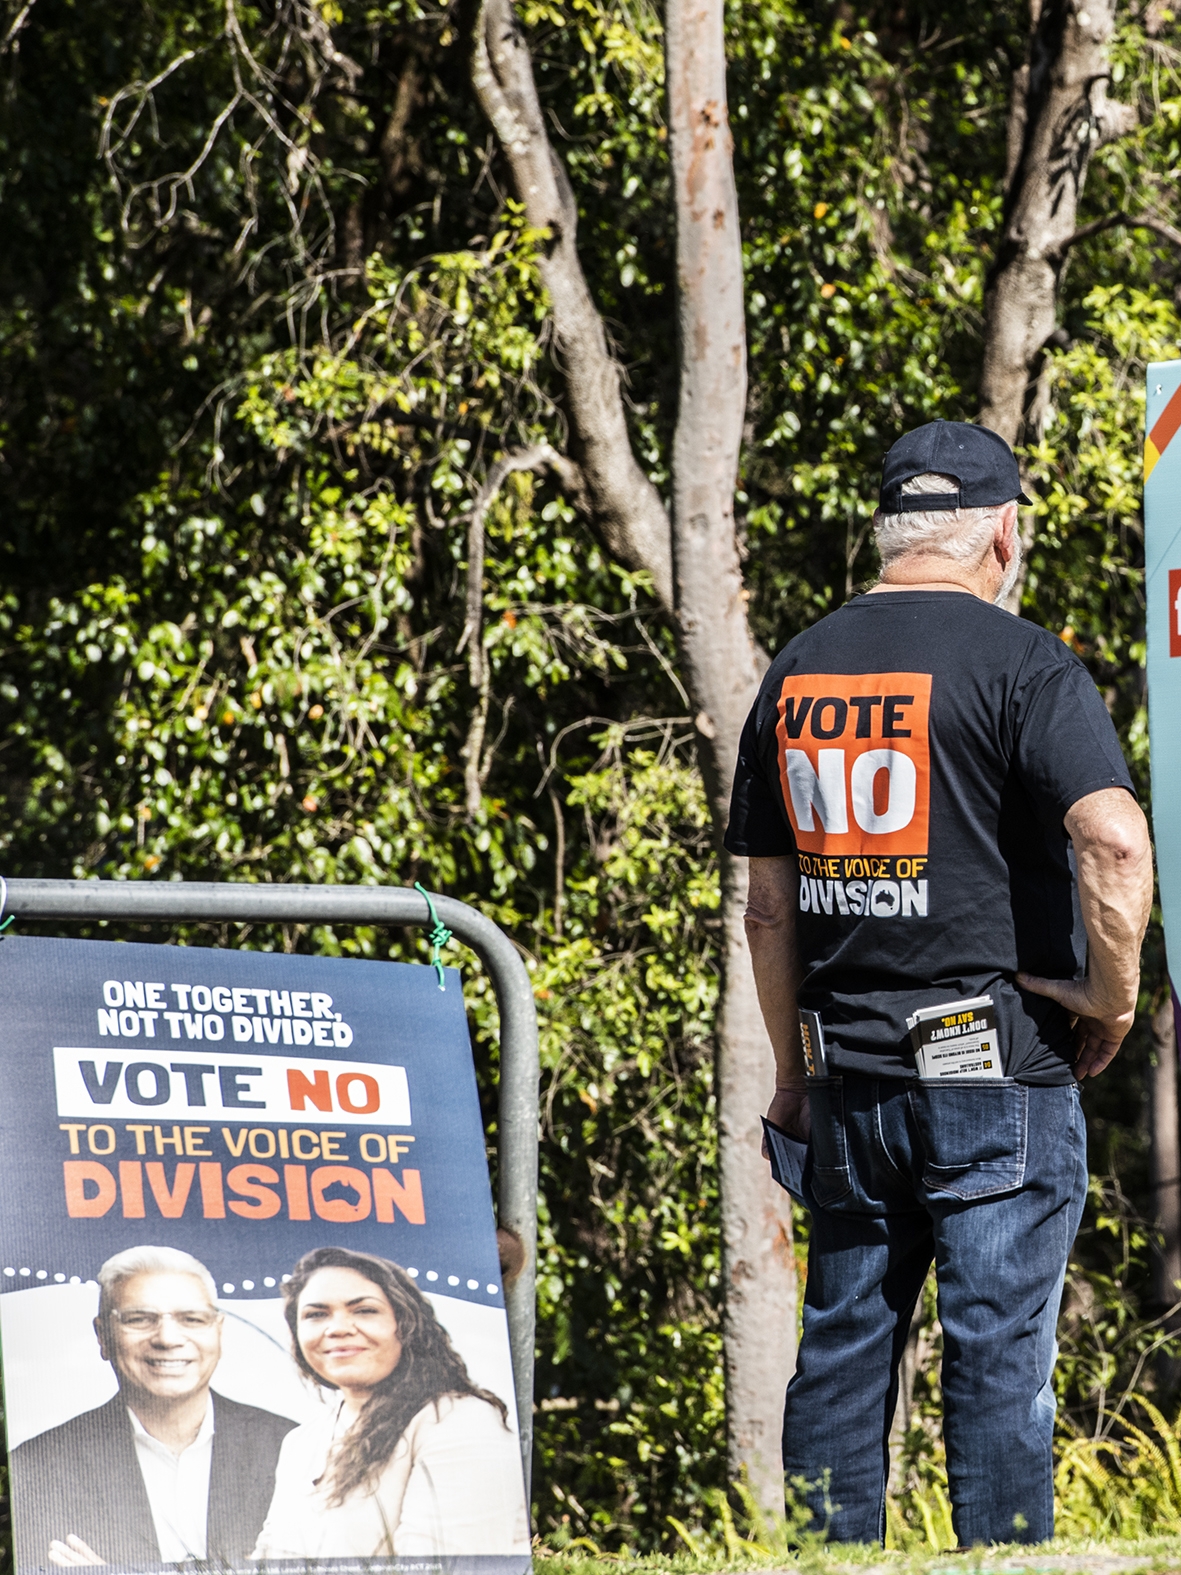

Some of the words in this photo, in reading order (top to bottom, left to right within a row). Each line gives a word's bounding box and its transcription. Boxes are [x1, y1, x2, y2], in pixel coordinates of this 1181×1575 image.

[784, 695, 913, 741] VOTE
[785, 748, 916, 835] NO
[798, 854, 812, 875] TO
[813, 857, 840, 878] THE
[844, 857, 891, 878] VOICE
[896, 858, 928, 878] OF
[799, 875, 928, 918] DIVISION
[103, 980, 168, 1010] ONE
[171, 983, 342, 1022] TOGETHER,
[941, 1015, 957, 1027] NO.
[957, 1011, 974, 1025] SAY
[97, 1008, 157, 1038] NOT
[168, 1012, 224, 1041] TWO
[232, 1015, 354, 1048] DIVIDED
[930, 1025, 961, 1041] KNOW?
[961, 1019, 988, 1035] DON'T
[78, 1060, 267, 1110] VOTE
[286, 1068, 380, 1114] NO
[59, 1124, 116, 1155] TO
[125, 1124, 213, 1157] THE
[222, 1128, 349, 1162] VOICE
[359, 1132, 415, 1164] OF
[63, 1161, 426, 1225] DIVISION
